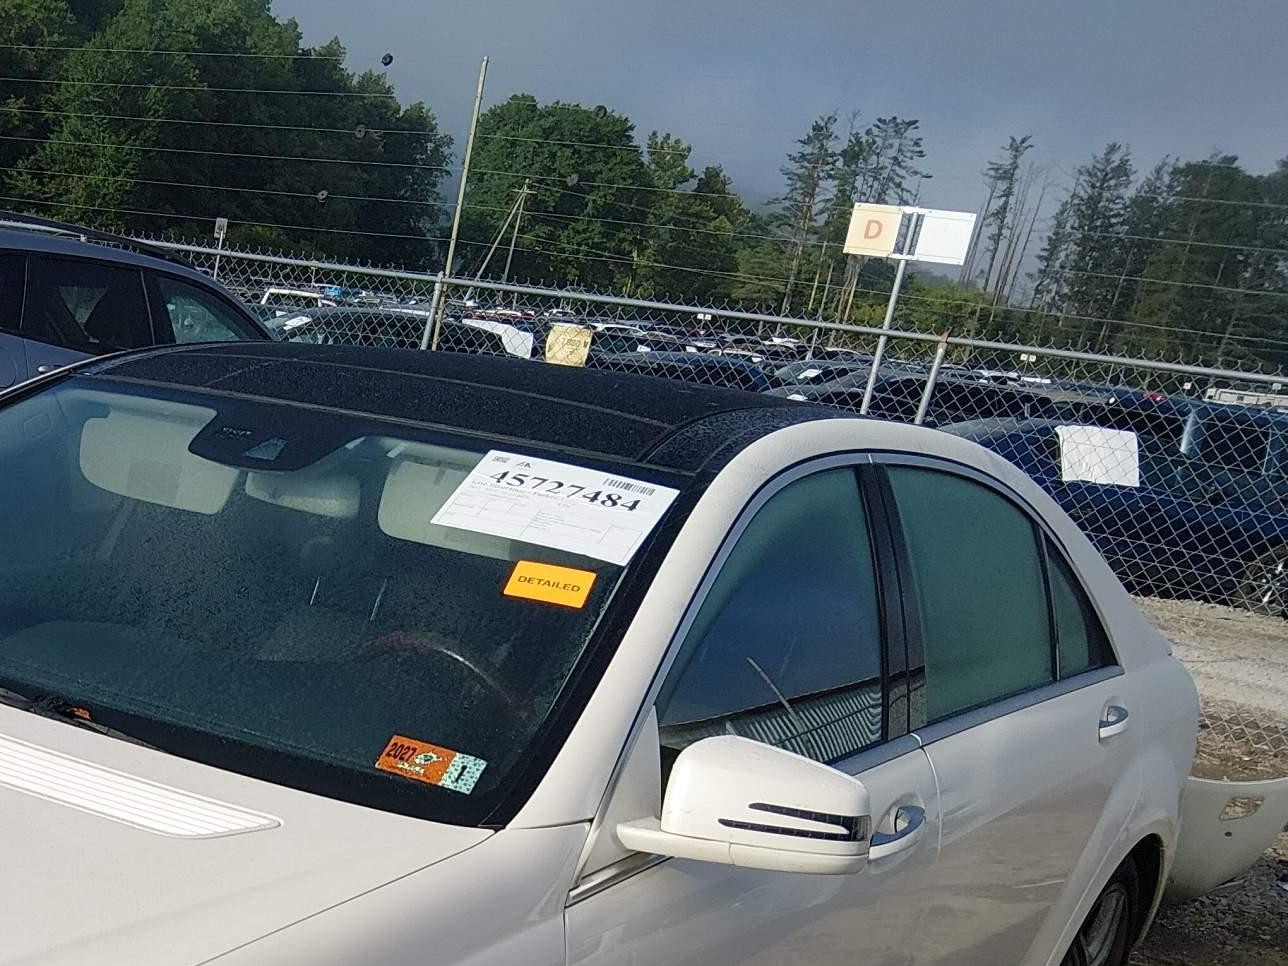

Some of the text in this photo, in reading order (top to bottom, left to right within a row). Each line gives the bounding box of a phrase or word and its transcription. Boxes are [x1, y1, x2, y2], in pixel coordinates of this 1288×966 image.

[863, 219, 883, 240] D
[490, 470, 641, 512] 45727484
[517, 574, 581, 593] DETAILED
[385, 742, 418, 763] 2027
